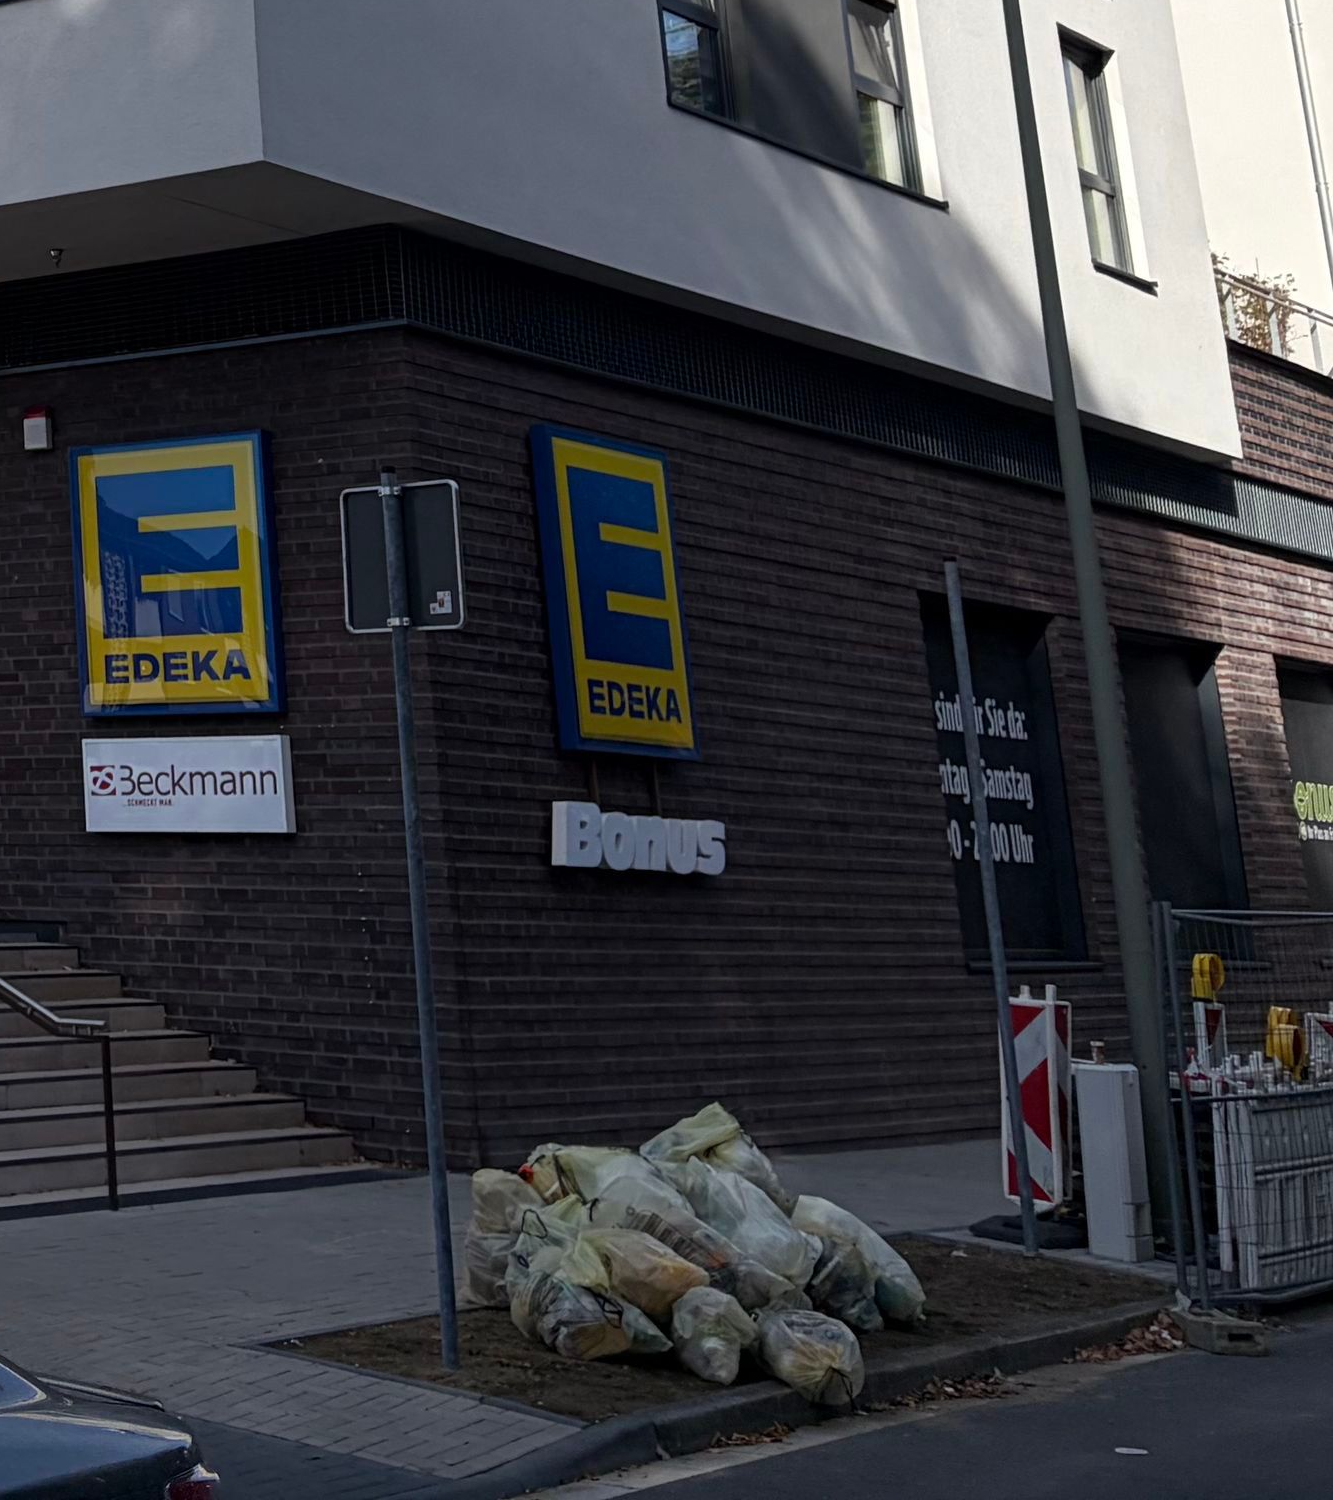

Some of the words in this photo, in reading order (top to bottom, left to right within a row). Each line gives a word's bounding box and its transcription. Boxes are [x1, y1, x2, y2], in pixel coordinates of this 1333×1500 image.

[105, 649, 252, 684] EDEKA
[587, 679, 682, 724] EDEKA
[935, 691, 964, 733] sind
[985, 698, 1007, 738] Sie
[1007, 702, 1028, 740] da:
[120, 764, 278, 796] Beckmann
[1010, 823, 1034, 864] Uhr
